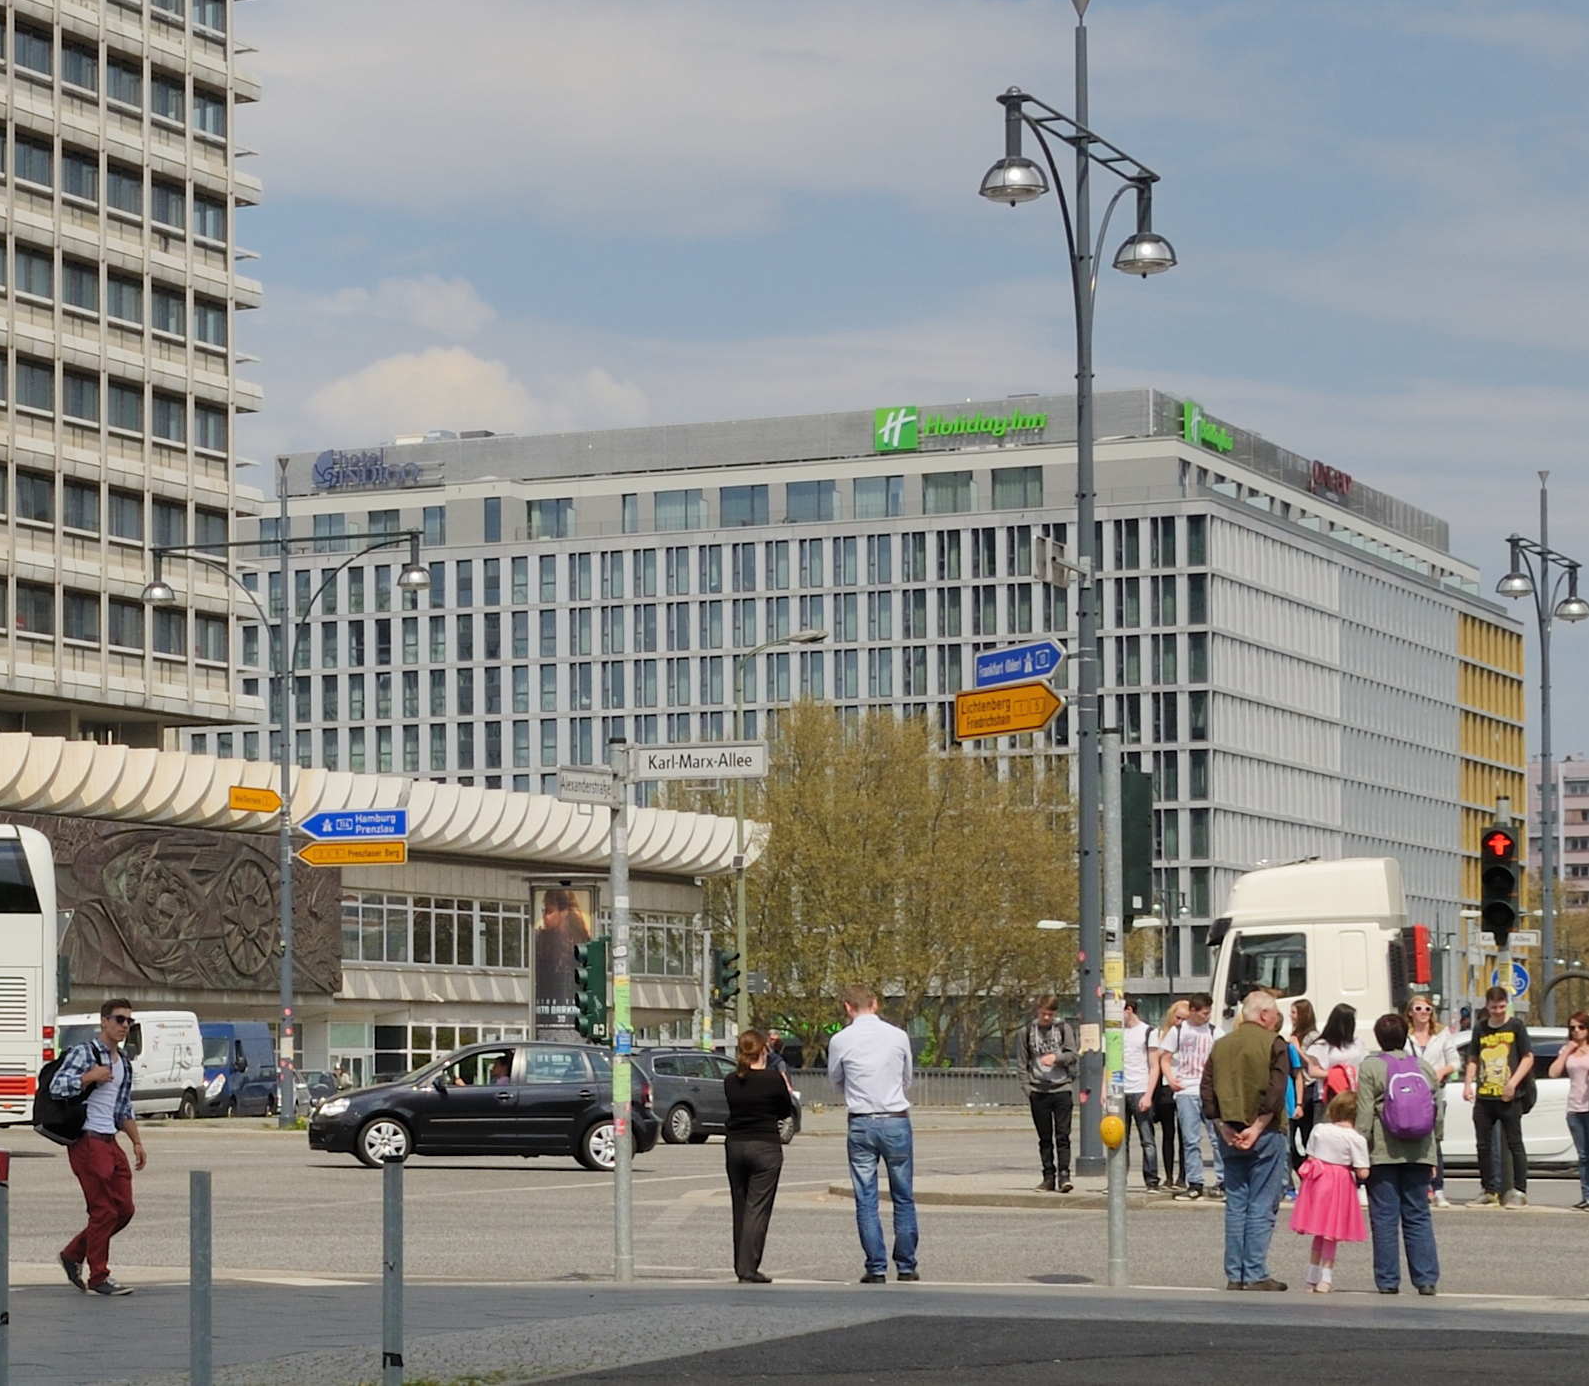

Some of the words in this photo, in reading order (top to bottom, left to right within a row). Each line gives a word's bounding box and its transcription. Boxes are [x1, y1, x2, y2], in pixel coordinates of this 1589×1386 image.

[924, 412, 1008, 436] Holiday
[1012, 408, 1047, 430] Inn
[339, 447, 384, 467] hotel
[337, 462, 420, 486] INDIGO
[961, 698, 1011, 715] Lichtenberg
[966, 715, 1011, 730] Friedrichshain
[648, 752, 752, 770] Karl-Marx-Allee
[355, 814, 396, 825] Hamburg
[355, 825, 395, 834] Prenzlau
[347, 848, 382, 858] Prenzlauer
[385, 848, 400, 859] Berg
